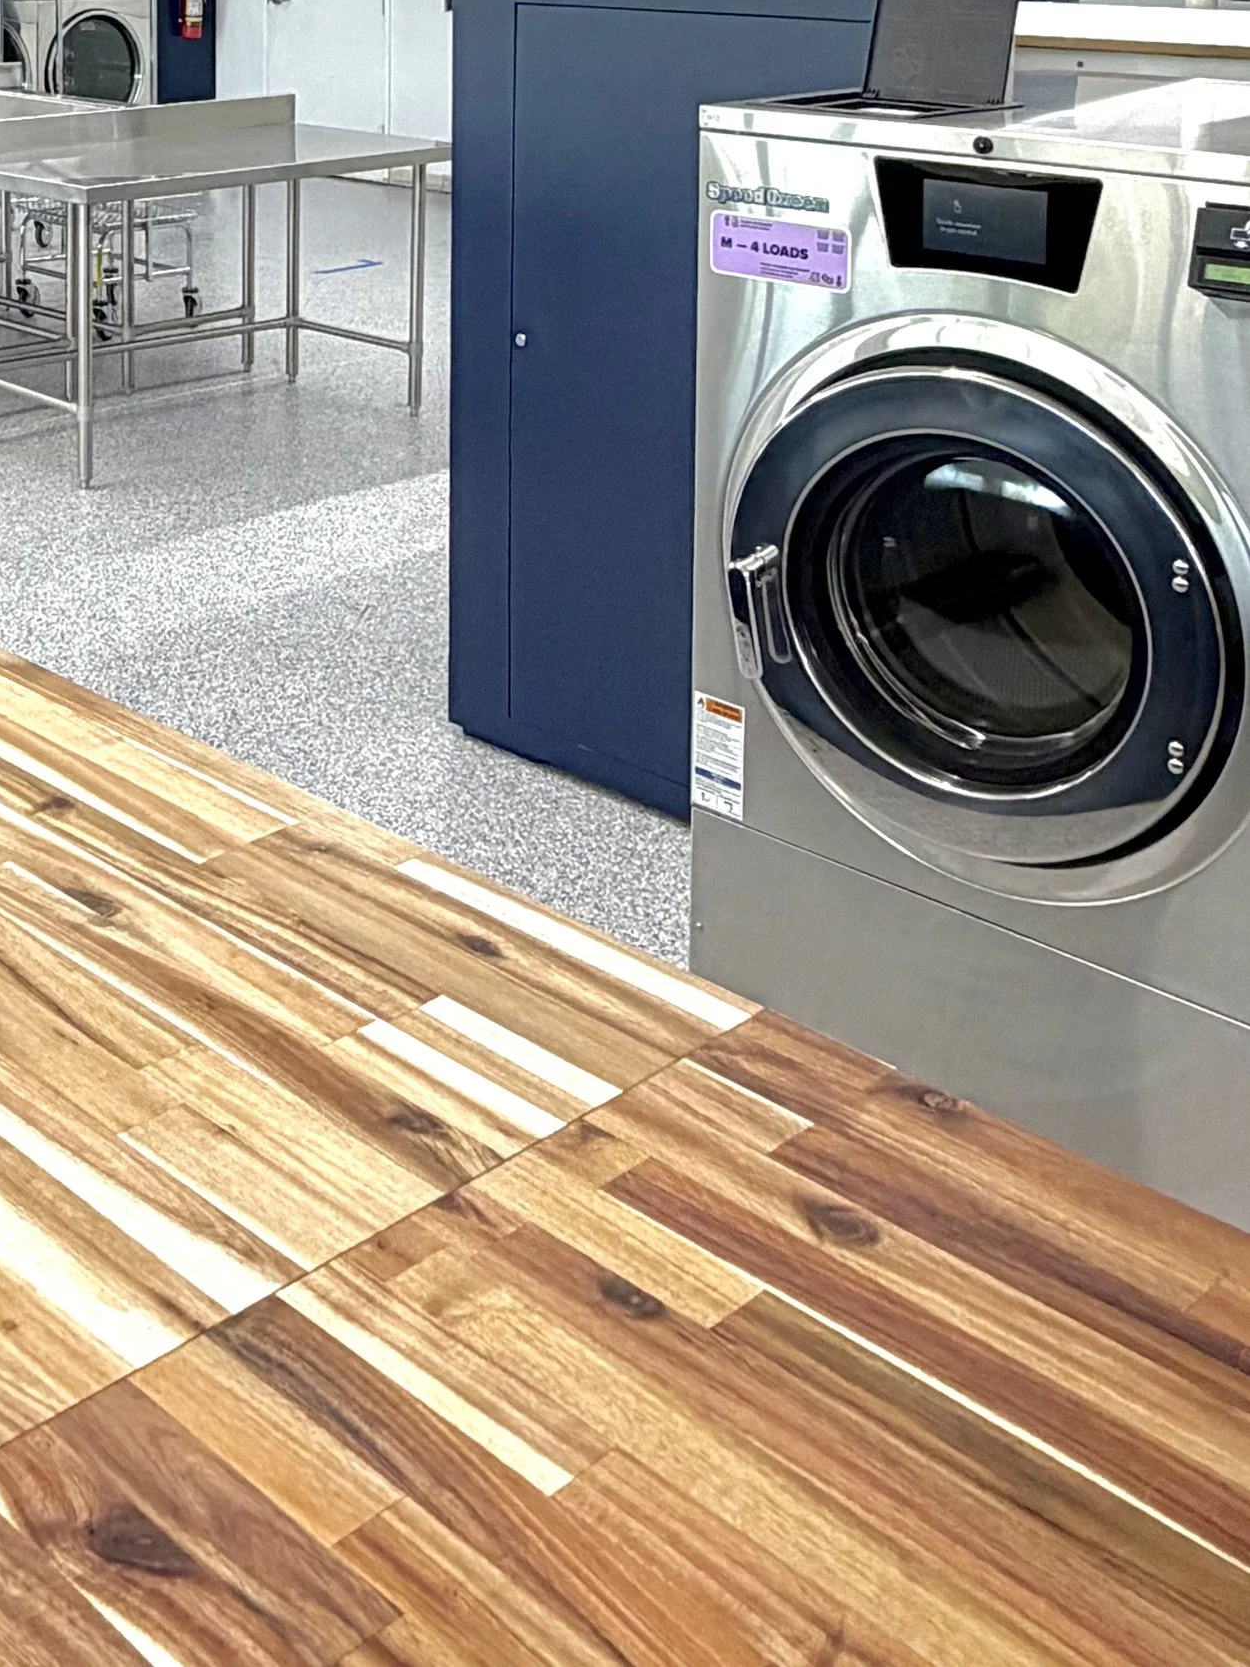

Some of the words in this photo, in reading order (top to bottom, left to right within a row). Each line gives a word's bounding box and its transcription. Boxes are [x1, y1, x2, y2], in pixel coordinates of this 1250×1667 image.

[720, 236, 733, 249] M
[750, 241, 760, 253] 4
[763, 242, 809, 259] LOADS
